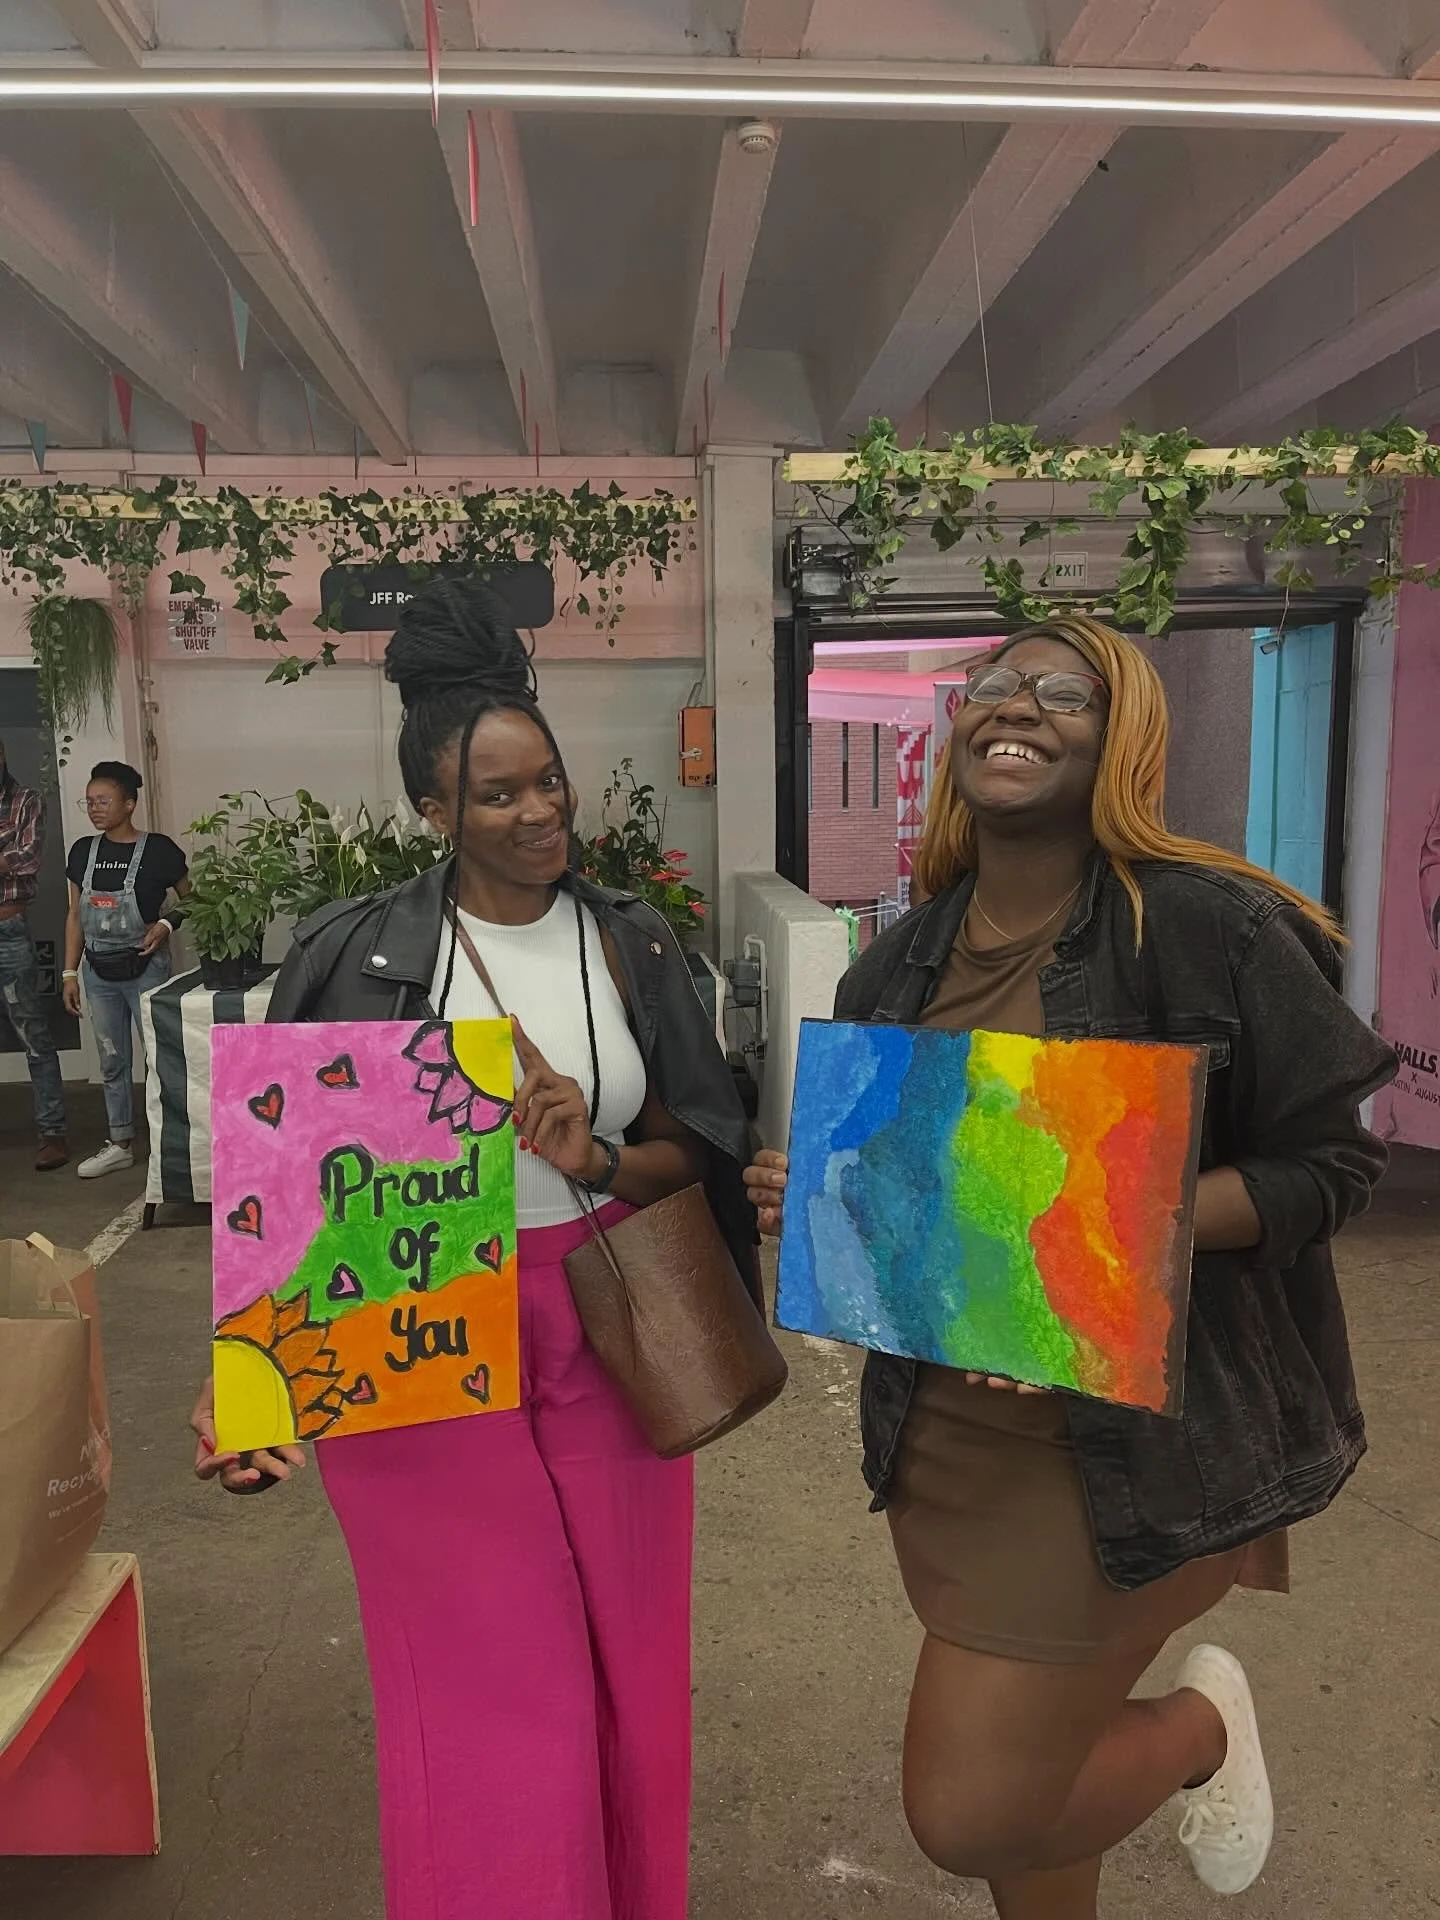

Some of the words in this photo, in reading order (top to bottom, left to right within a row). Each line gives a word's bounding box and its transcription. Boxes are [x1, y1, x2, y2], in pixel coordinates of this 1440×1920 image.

[369, 591, 393, 605] JFF
[175, 626, 217, 638] SHUT-OFF
[183, 638, 210, 651] VALVE
[319, 1142, 480, 1223] Proud
